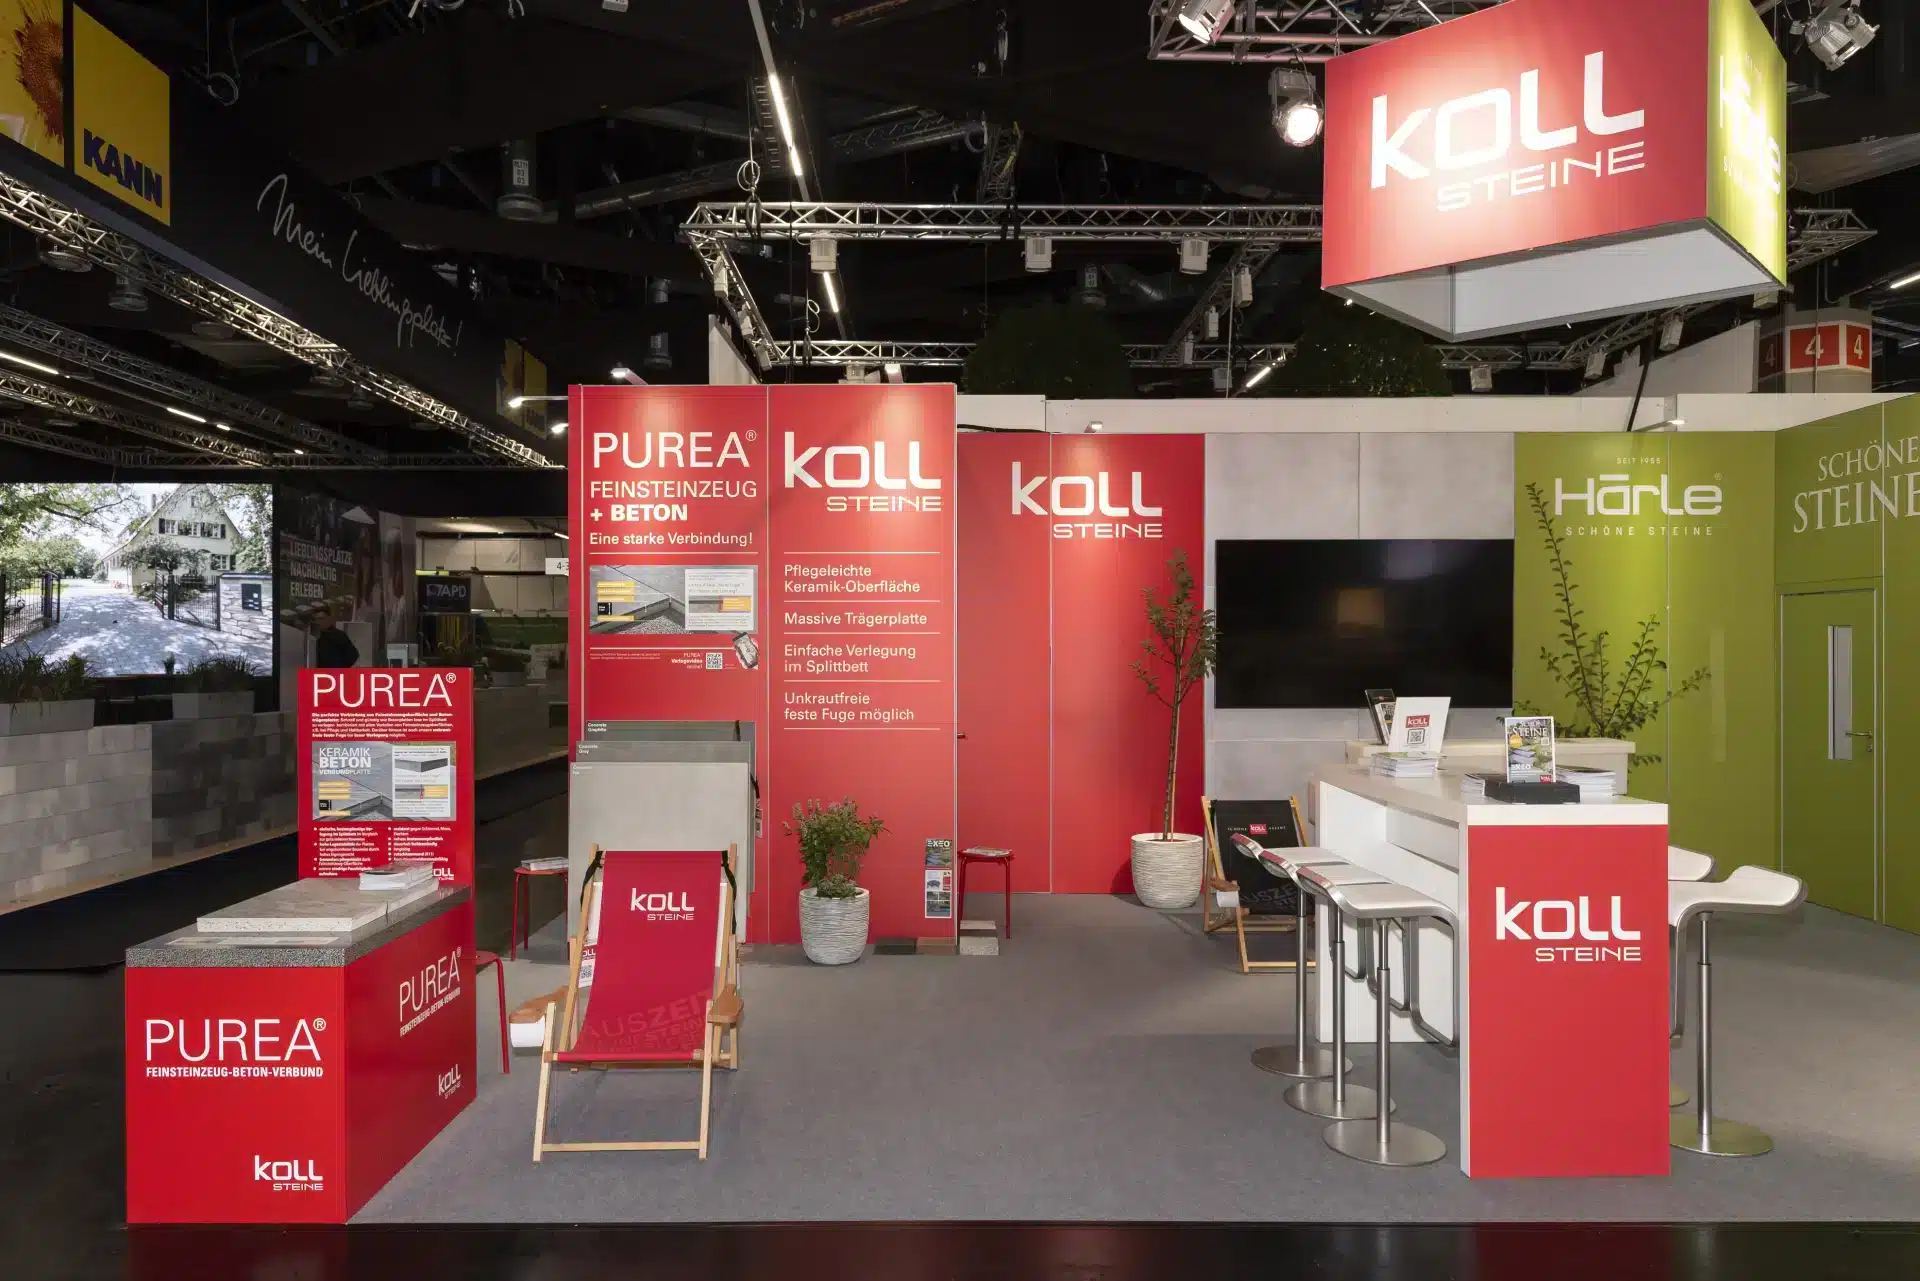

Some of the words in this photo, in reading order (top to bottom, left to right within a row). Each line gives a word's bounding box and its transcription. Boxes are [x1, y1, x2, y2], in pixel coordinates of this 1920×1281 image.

[83, 128, 163, 208] KANN
[1436, 141, 1645, 212] STEINE
[257, 173, 333, 268] Mein
[1805, 333, 1824, 359] 4
[1853, 334, 1863, 359] 4
[1616, 457, 1636, 465] SEIT
[1640, 457, 1661, 465] 1955
[1818, 436, 1919, 482] SCHÖNE
[590, 481, 757, 498] FEINSTEINZEUG
[826, 496, 942, 512] STEINE
[1793, 472, 1920, 533] STEINE
[611, 504, 688, 521] BETON
[1053, 523, 1162, 538] STEINE
[1565, 525, 1635, 536] SCHÖNE
[1648, 526, 1713, 536] STEINE
[590, 532, 619, 545] Eine
[623, 532, 664, 545] starke
[667, 532, 753, 547] Verbindung!
[784, 565, 872, 579] Pflegeleichte
[290, 582, 324, 598] ERLEBEN
[784, 580, 921, 593] Keramik-Oberfläche
[784, 613, 841, 625] Massive
[845, 612, 928, 627] Trägerplatte
[784, 644, 843, 657] Einfache
[846, 644, 916, 659] Verlegung
[784, 660, 802, 673] im
[806, 660, 869, 674] Splittbett
[784, 692, 870, 704] Unkrautfreie
[784, 708, 818, 720] feste
[822, 708, 856, 723] Fuge
[860, 708, 914, 723] möglich
[1512, 727, 1547, 737] STEINE
[319, 748, 371, 757] KERAMIK
[319, 757, 371, 768] BETON
[1535, 947, 1642, 962] STEINE
[146, 1067, 324, 1077] FEINSTEINZEUG-BETON-VERBUND
[273, 1183, 324, 1191] STEINE
